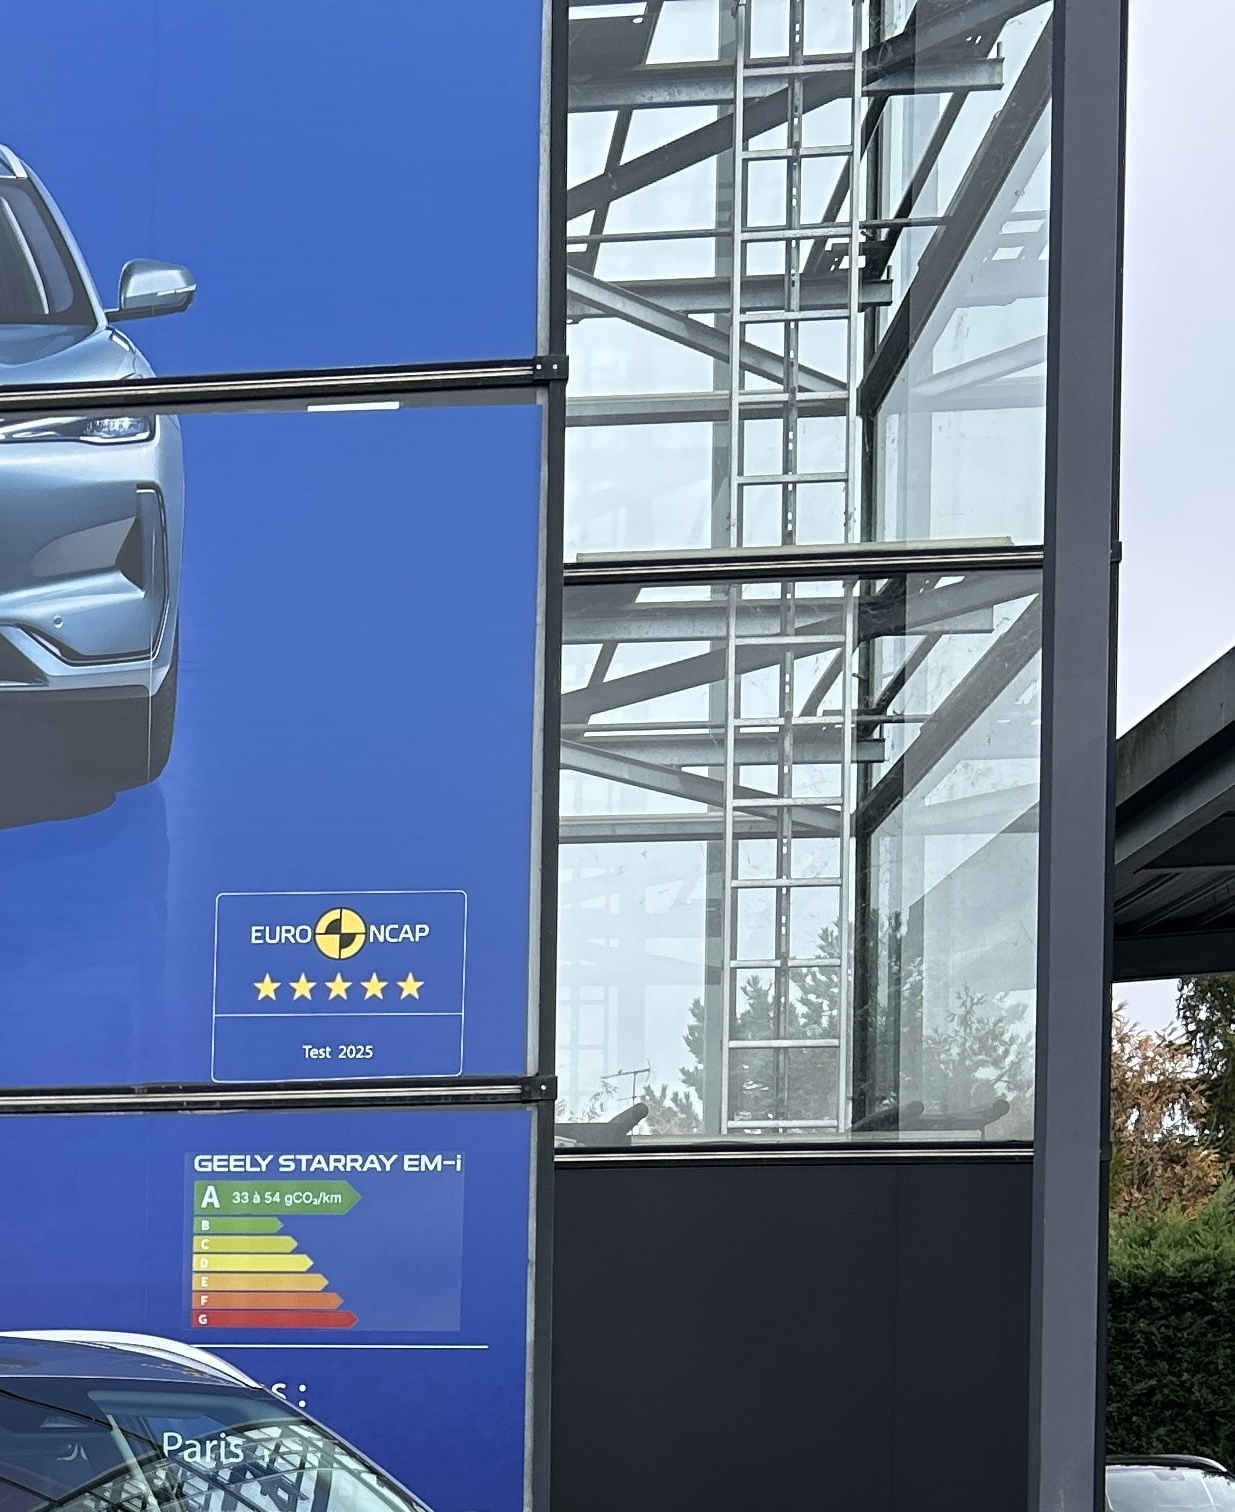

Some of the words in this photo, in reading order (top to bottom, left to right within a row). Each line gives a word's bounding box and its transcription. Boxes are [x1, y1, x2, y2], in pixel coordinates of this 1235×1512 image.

[251, 925, 311, 943] EURO
[370, 924, 429, 942] NCAP
[303, 1045, 331, 1058] Test
[339, 1045, 373, 1058] 2025
[194, 1155, 273, 1171] GEELY
[279, 1155, 398, 1171] STARRAY
[404, 1155, 462, 1171] EM-i
[201, 1186, 220, 1208] A
[232, 1192, 249, 1203] 33
[253, 1190, 260, 1203] à
[264, 1192, 280, 1203] 54
[201, 1219, 210, 1231] B
[200, 1238, 209, 1250] C
[200, 1257, 209, 1269] D
[201, 1276, 209, 1288] E
[200, 1295, 209, 1306] F
[198, 1314, 208, 1325] G
[162, 1432, 245, 1463] Paris
